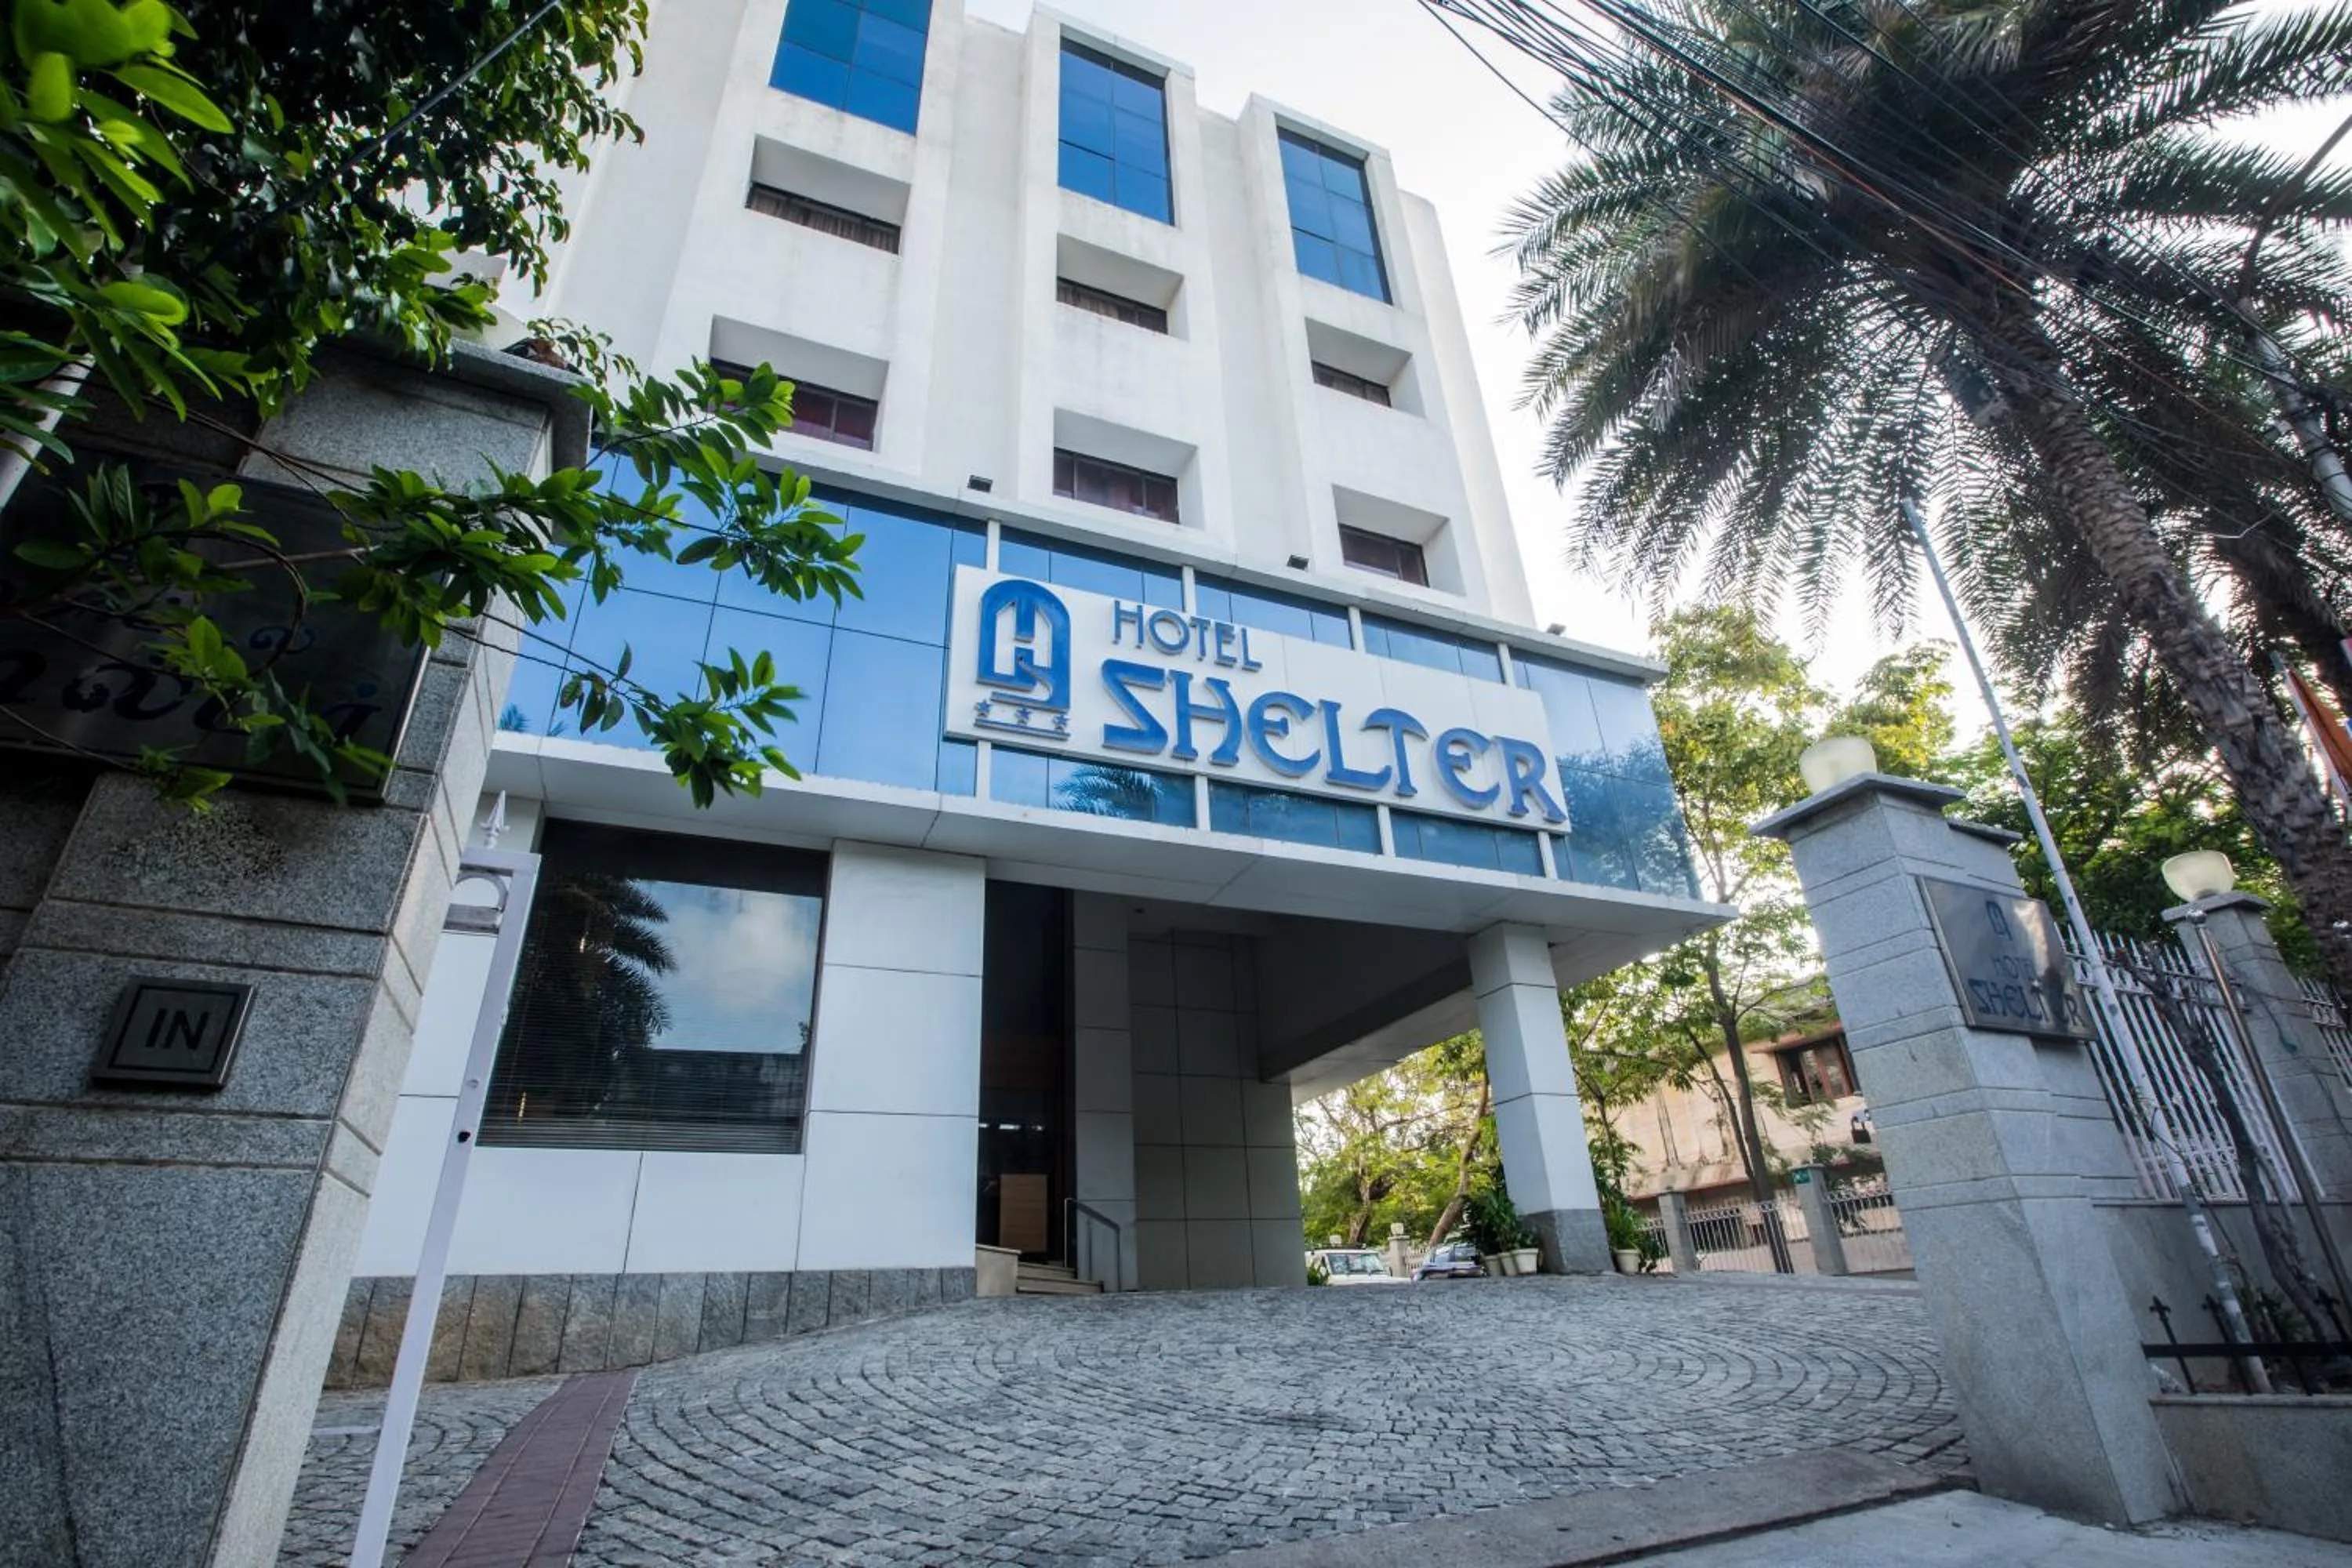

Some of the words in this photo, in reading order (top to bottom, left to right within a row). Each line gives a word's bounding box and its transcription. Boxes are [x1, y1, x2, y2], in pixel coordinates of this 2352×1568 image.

[1112, 599, 1262, 672] HOTEL
[1102, 658, 1567, 823] SHELTER
[145, 1008, 212, 1050] IN
